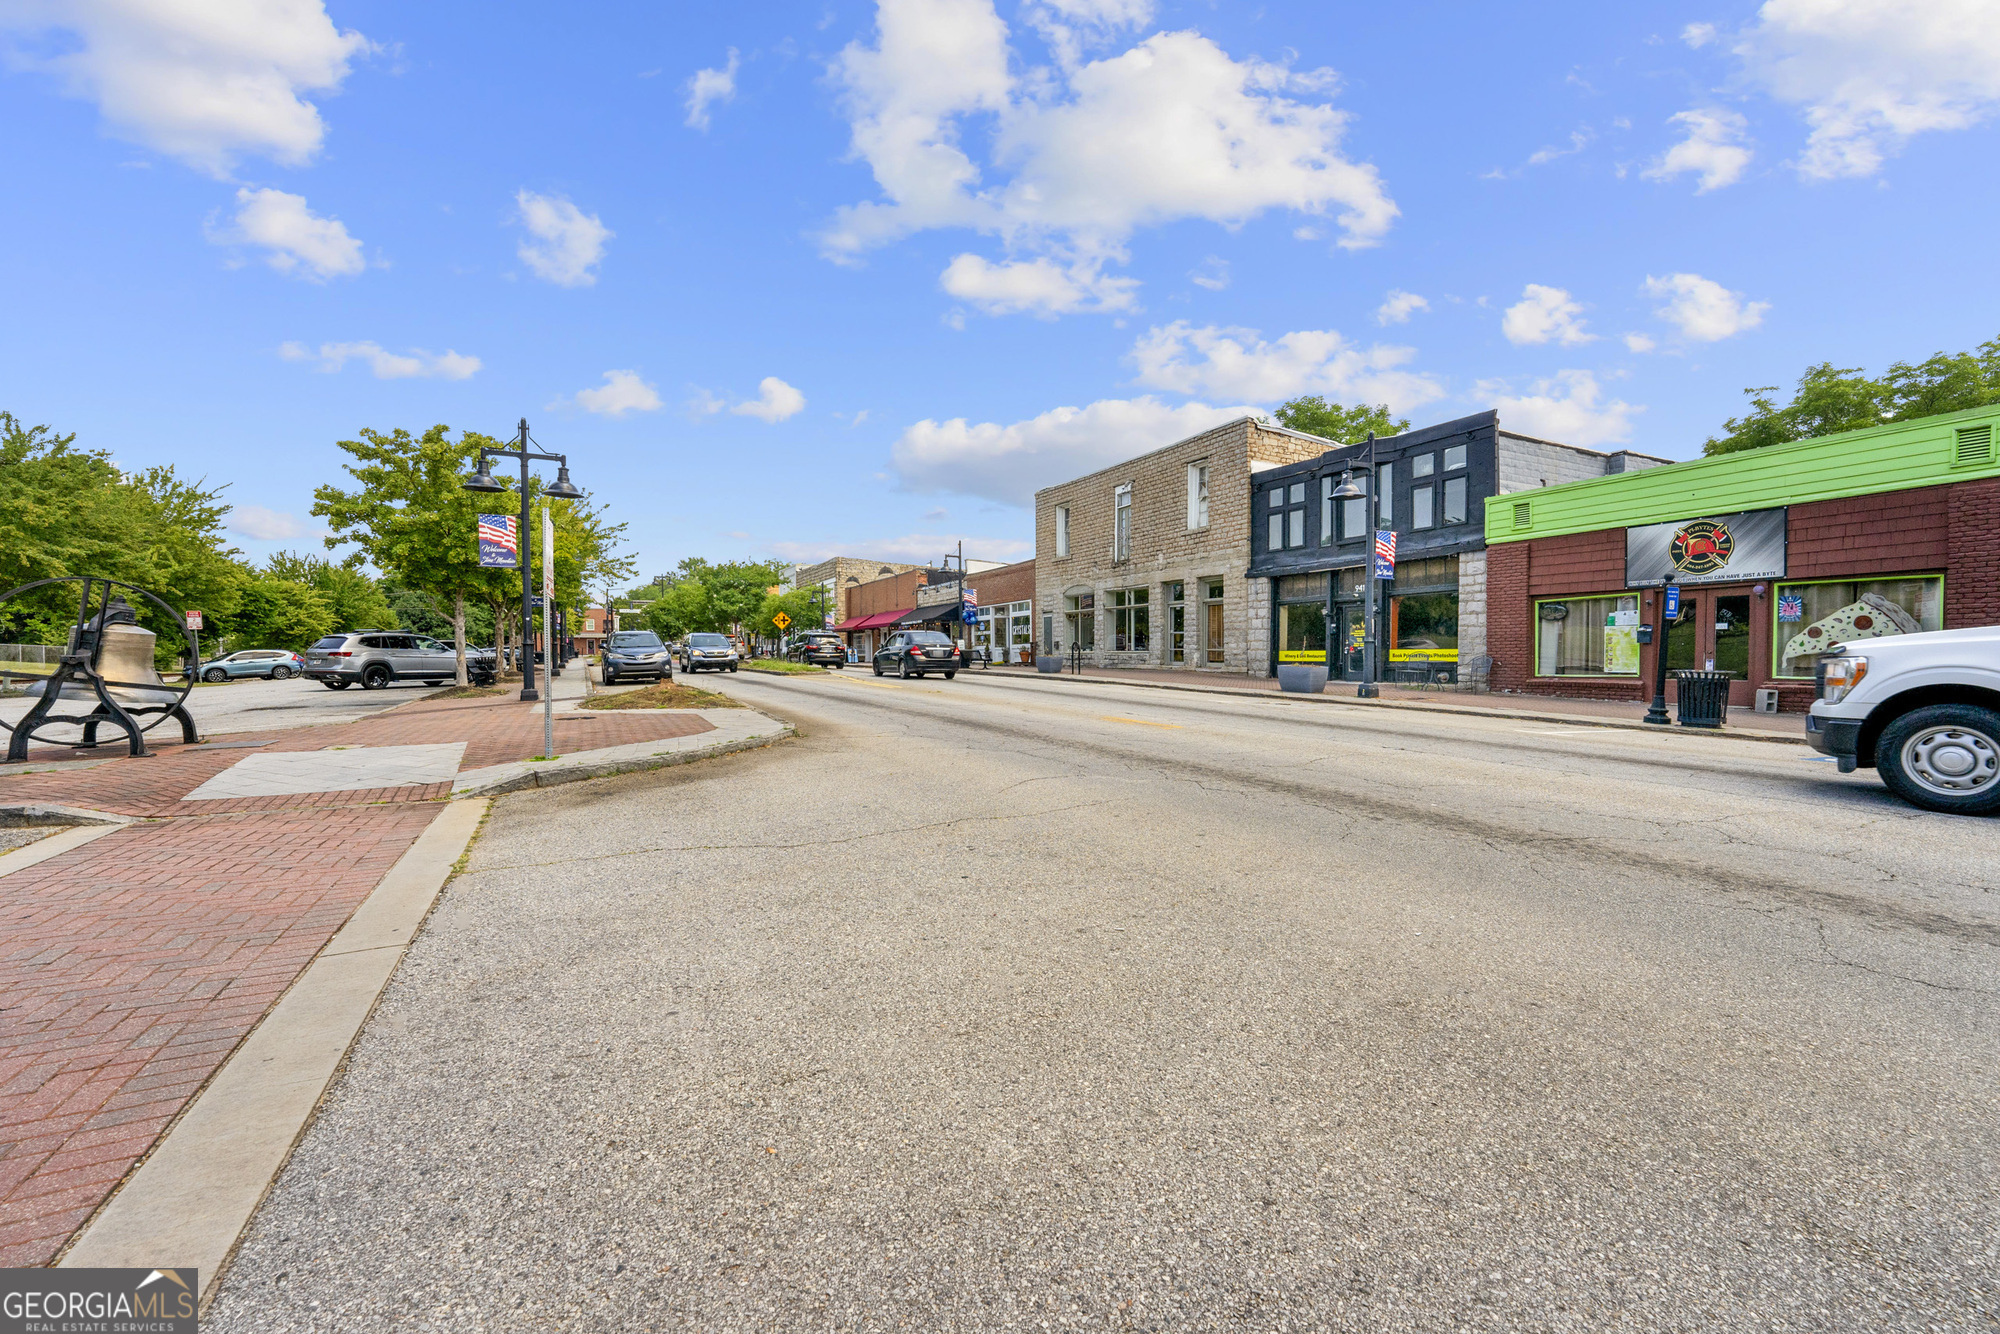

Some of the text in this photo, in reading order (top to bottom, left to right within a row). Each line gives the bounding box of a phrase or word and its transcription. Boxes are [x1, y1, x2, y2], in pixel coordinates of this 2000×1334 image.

[481, 544, 507, 552] Welcome
[1355, 584, 1365, 592] 941
[1012, 625, 1031, 635] CRYSTALS
